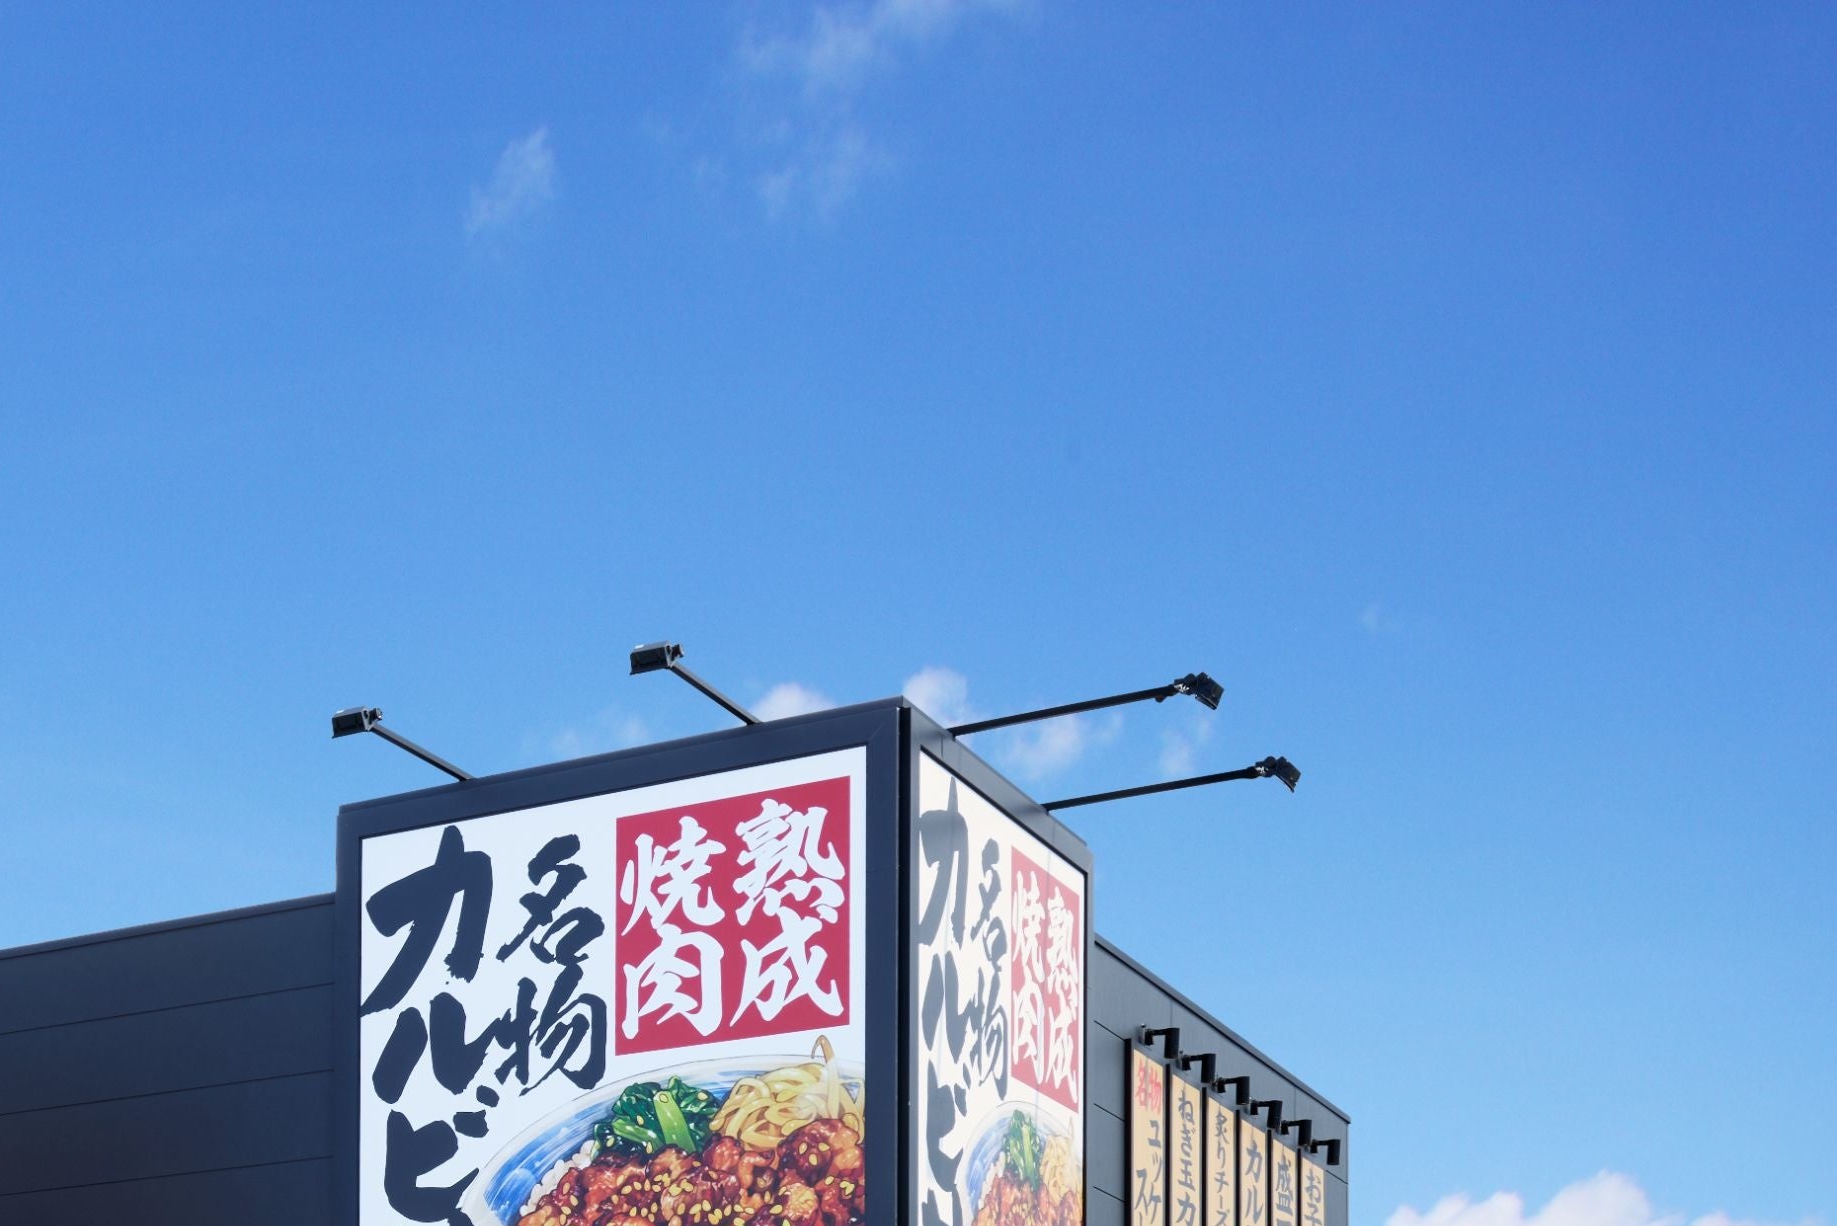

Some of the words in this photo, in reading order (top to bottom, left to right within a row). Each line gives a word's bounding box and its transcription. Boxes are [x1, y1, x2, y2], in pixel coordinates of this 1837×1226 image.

[496, 834, 608, 1097] 名物
[620, 816, 727, 1041] 焼肉
[729, 798, 845, 1028] 熟成
[965, 838, 1009, 1101] 名物
[1011, 870, 1045, 1081] 焼肉
[1044, 887, 1080, 1104] 熟成
